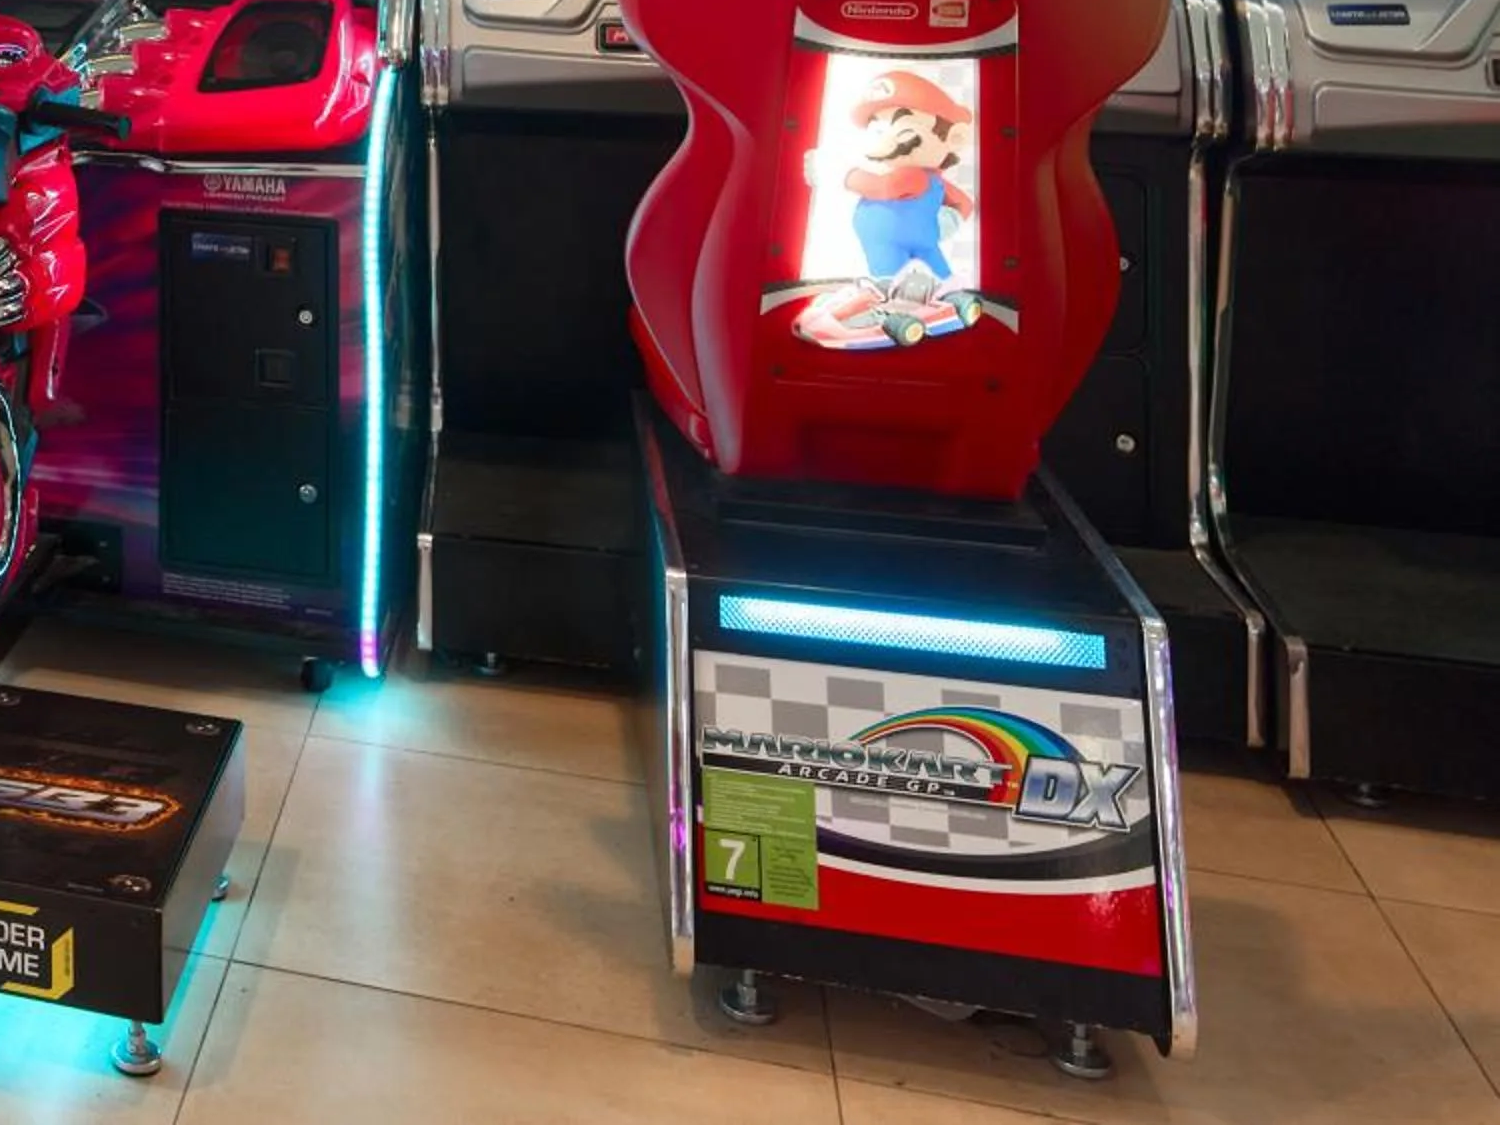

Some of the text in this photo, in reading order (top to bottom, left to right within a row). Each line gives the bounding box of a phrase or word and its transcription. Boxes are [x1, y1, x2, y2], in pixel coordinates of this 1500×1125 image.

[223, 176, 286, 195] YAMAHA
[777, 764, 888, 788] ARCADE
[1016, 756, 1138, 827] DX
[719, 838, 746, 881] 7
